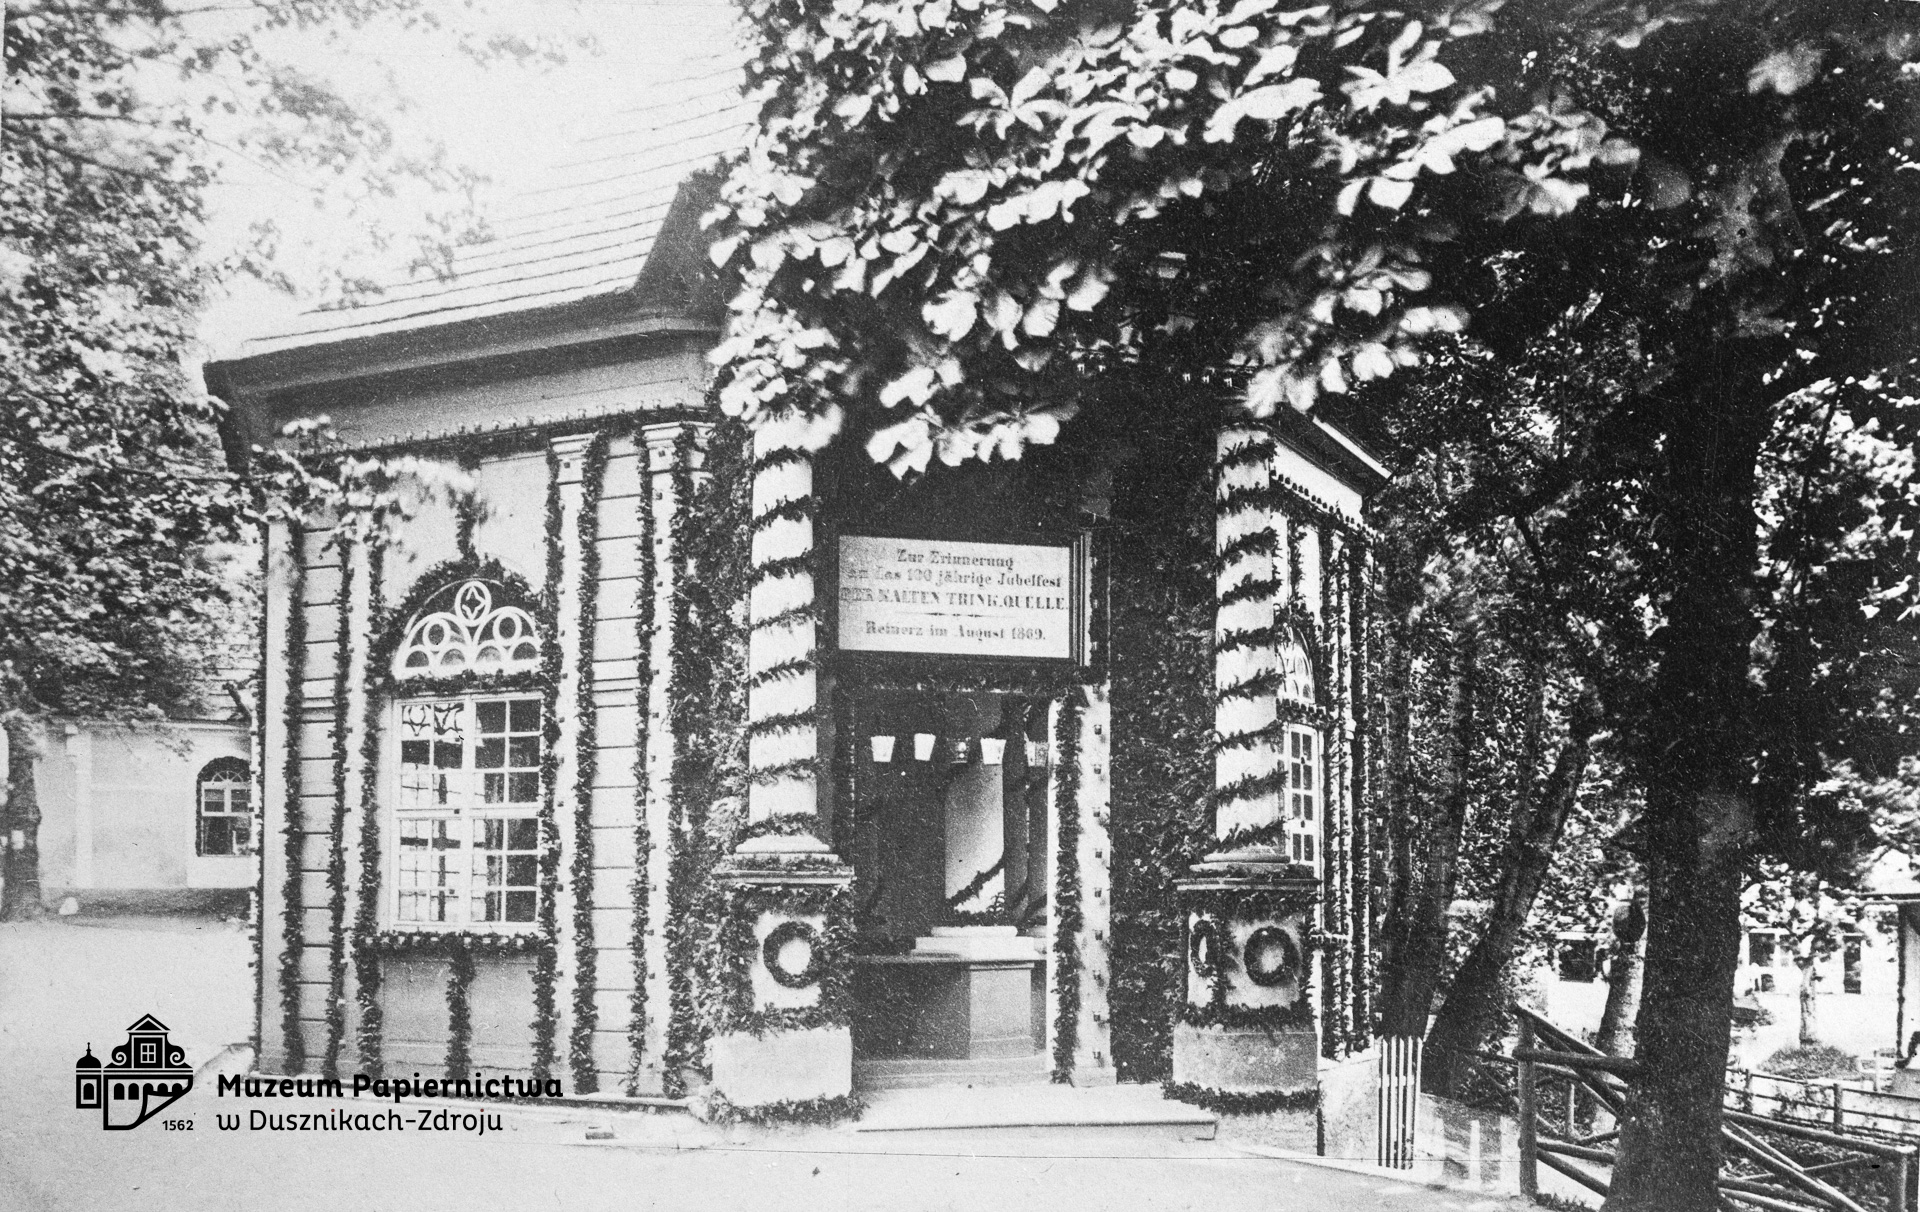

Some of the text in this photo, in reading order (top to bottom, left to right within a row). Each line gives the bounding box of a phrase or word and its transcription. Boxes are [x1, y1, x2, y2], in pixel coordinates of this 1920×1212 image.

[896, 548, 1014, 572] Zur Erinnerung
[935, 569, 992, 588] jährige
[997, 571, 1062, 588] Jubelfest
[839, 586, 874, 603] DER
[878, 588, 940, 605] KALTEN
[865, 620, 1046, 641] Reinerz im August 1869.
